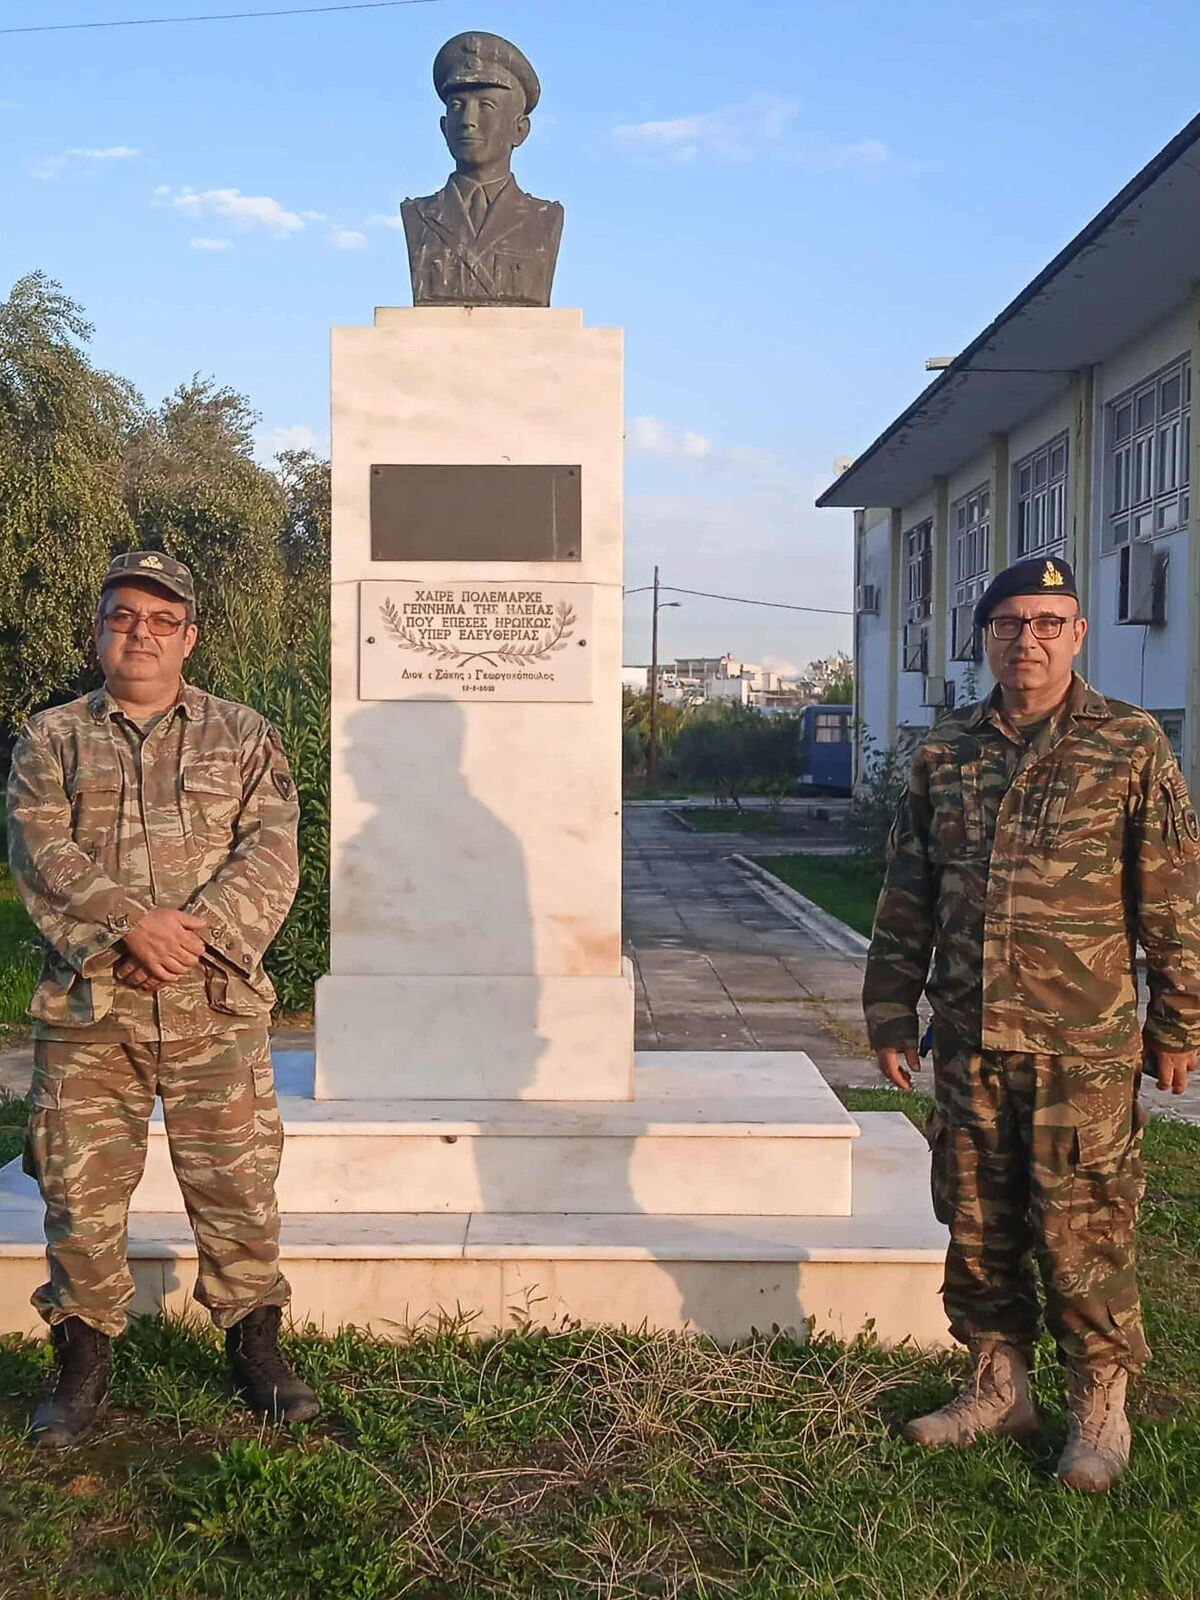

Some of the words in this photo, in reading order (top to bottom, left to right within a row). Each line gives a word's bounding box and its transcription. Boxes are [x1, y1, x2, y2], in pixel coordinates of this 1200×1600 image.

[415, 590, 454, 602] ΧΑΙΡΕ
[461, 591, 543, 603] ΠΟΛΕΜΑΡΧΕ
[403, 603, 466, 615] ΓΕΝΝΗΜΑ
[473, 604, 499, 615] ΤΗΣ
[506, 604, 554, 616] ΗΛΕΙΑΣ
[406, 616, 434, 628] ΠΟΥ
[442, 617, 488, 628] ΕΠΕΣΕΣ
[495, 617, 551, 629] ΗΡΩΙΚΩΣ
[418, 629, 452, 640] ΥΠΕΡ
[459, 629, 540, 641] ΕΛΕΥΘΕΡΙΑΣ
